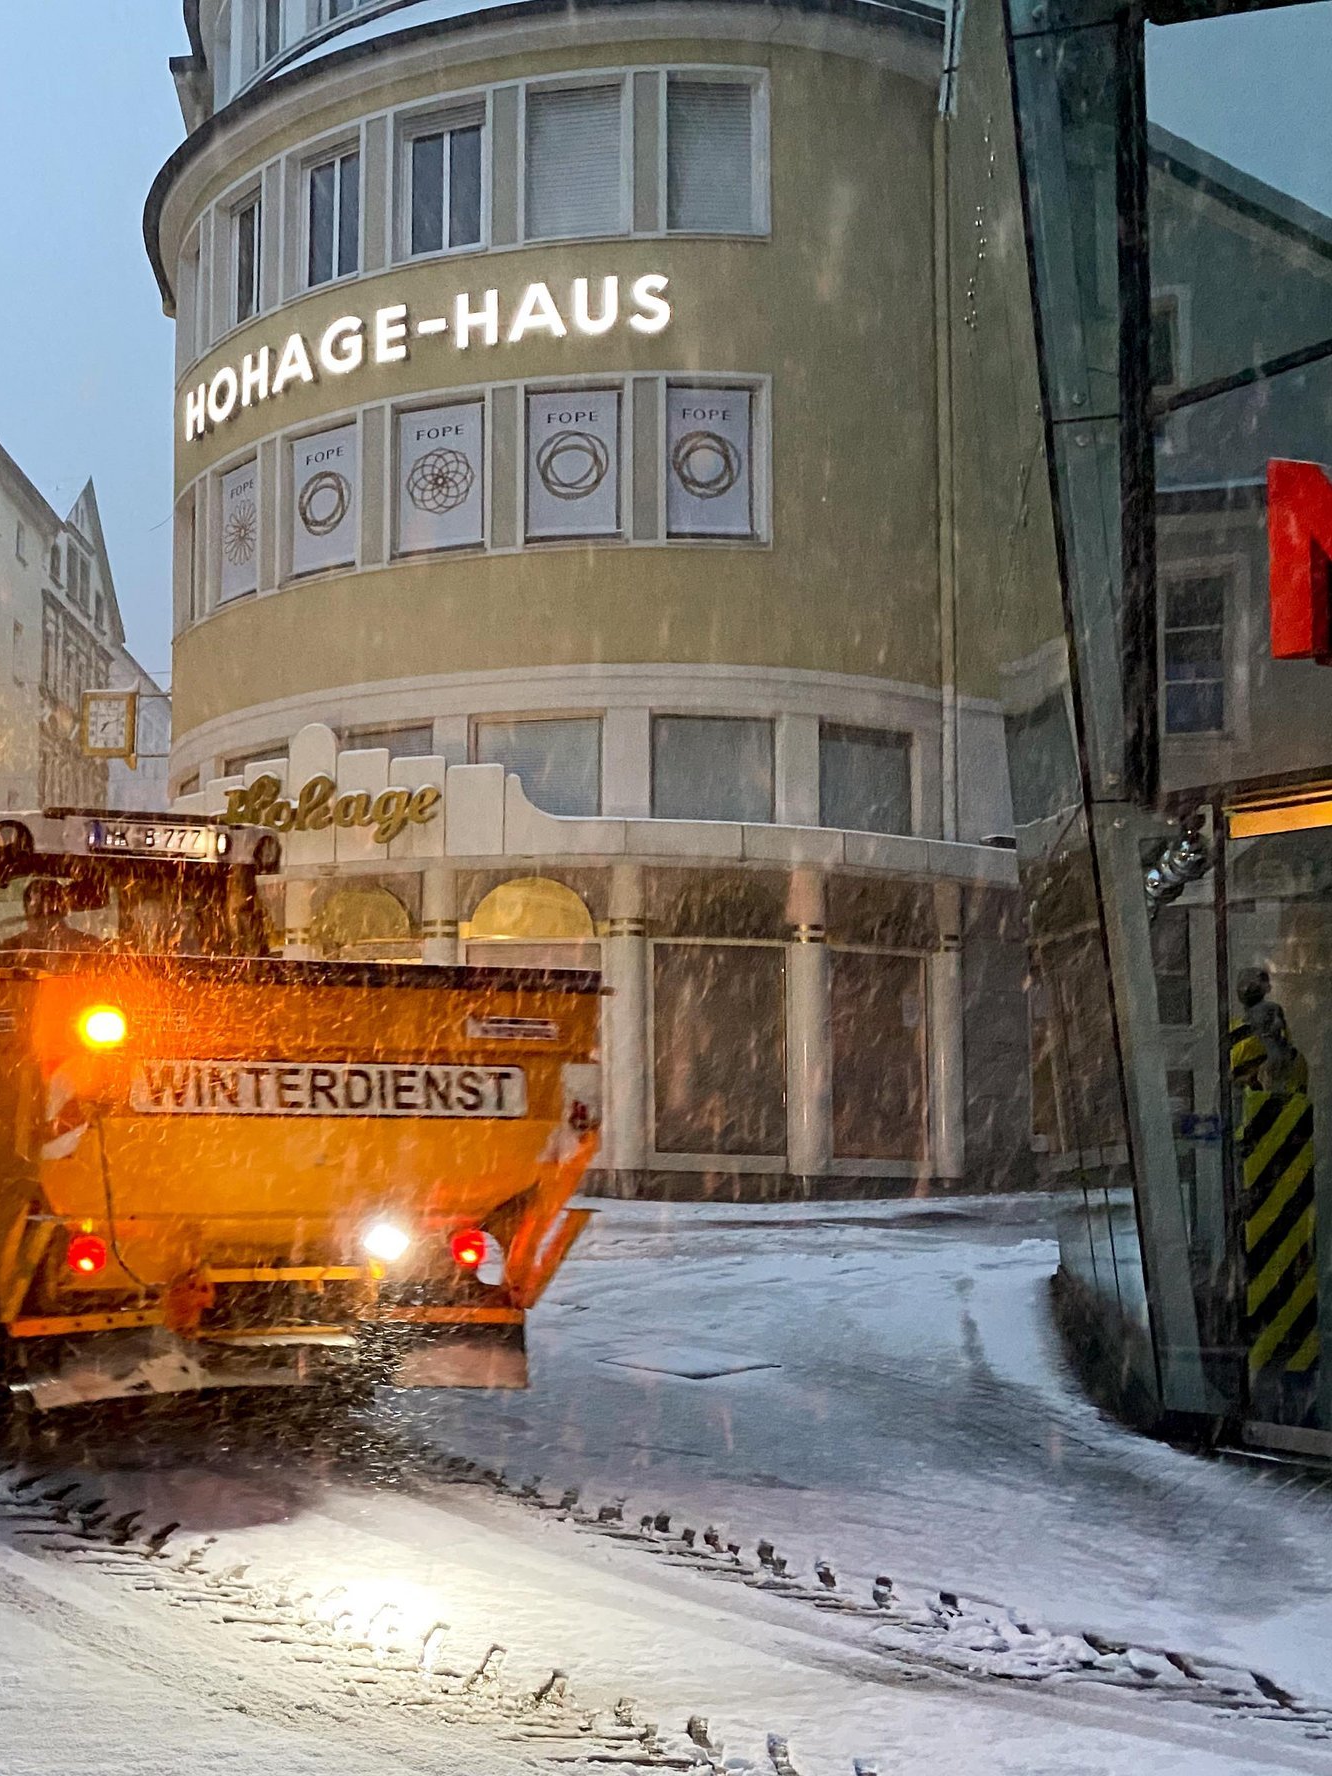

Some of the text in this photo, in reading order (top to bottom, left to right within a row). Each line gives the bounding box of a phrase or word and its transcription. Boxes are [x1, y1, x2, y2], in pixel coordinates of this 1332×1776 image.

[184, 273, 673, 441] HOHAGE-HAUS
[546, 410, 599, 425] FOPE
[681, 407, 733, 422] FOPE
[415, 423, 465, 441] FOPE
[305, 445, 344, 467] FOPE
[229, 477, 254, 499] FOPE
[218, 773, 442, 844] Hohage
[141, 1063, 513, 1112] WINTERDIENST
